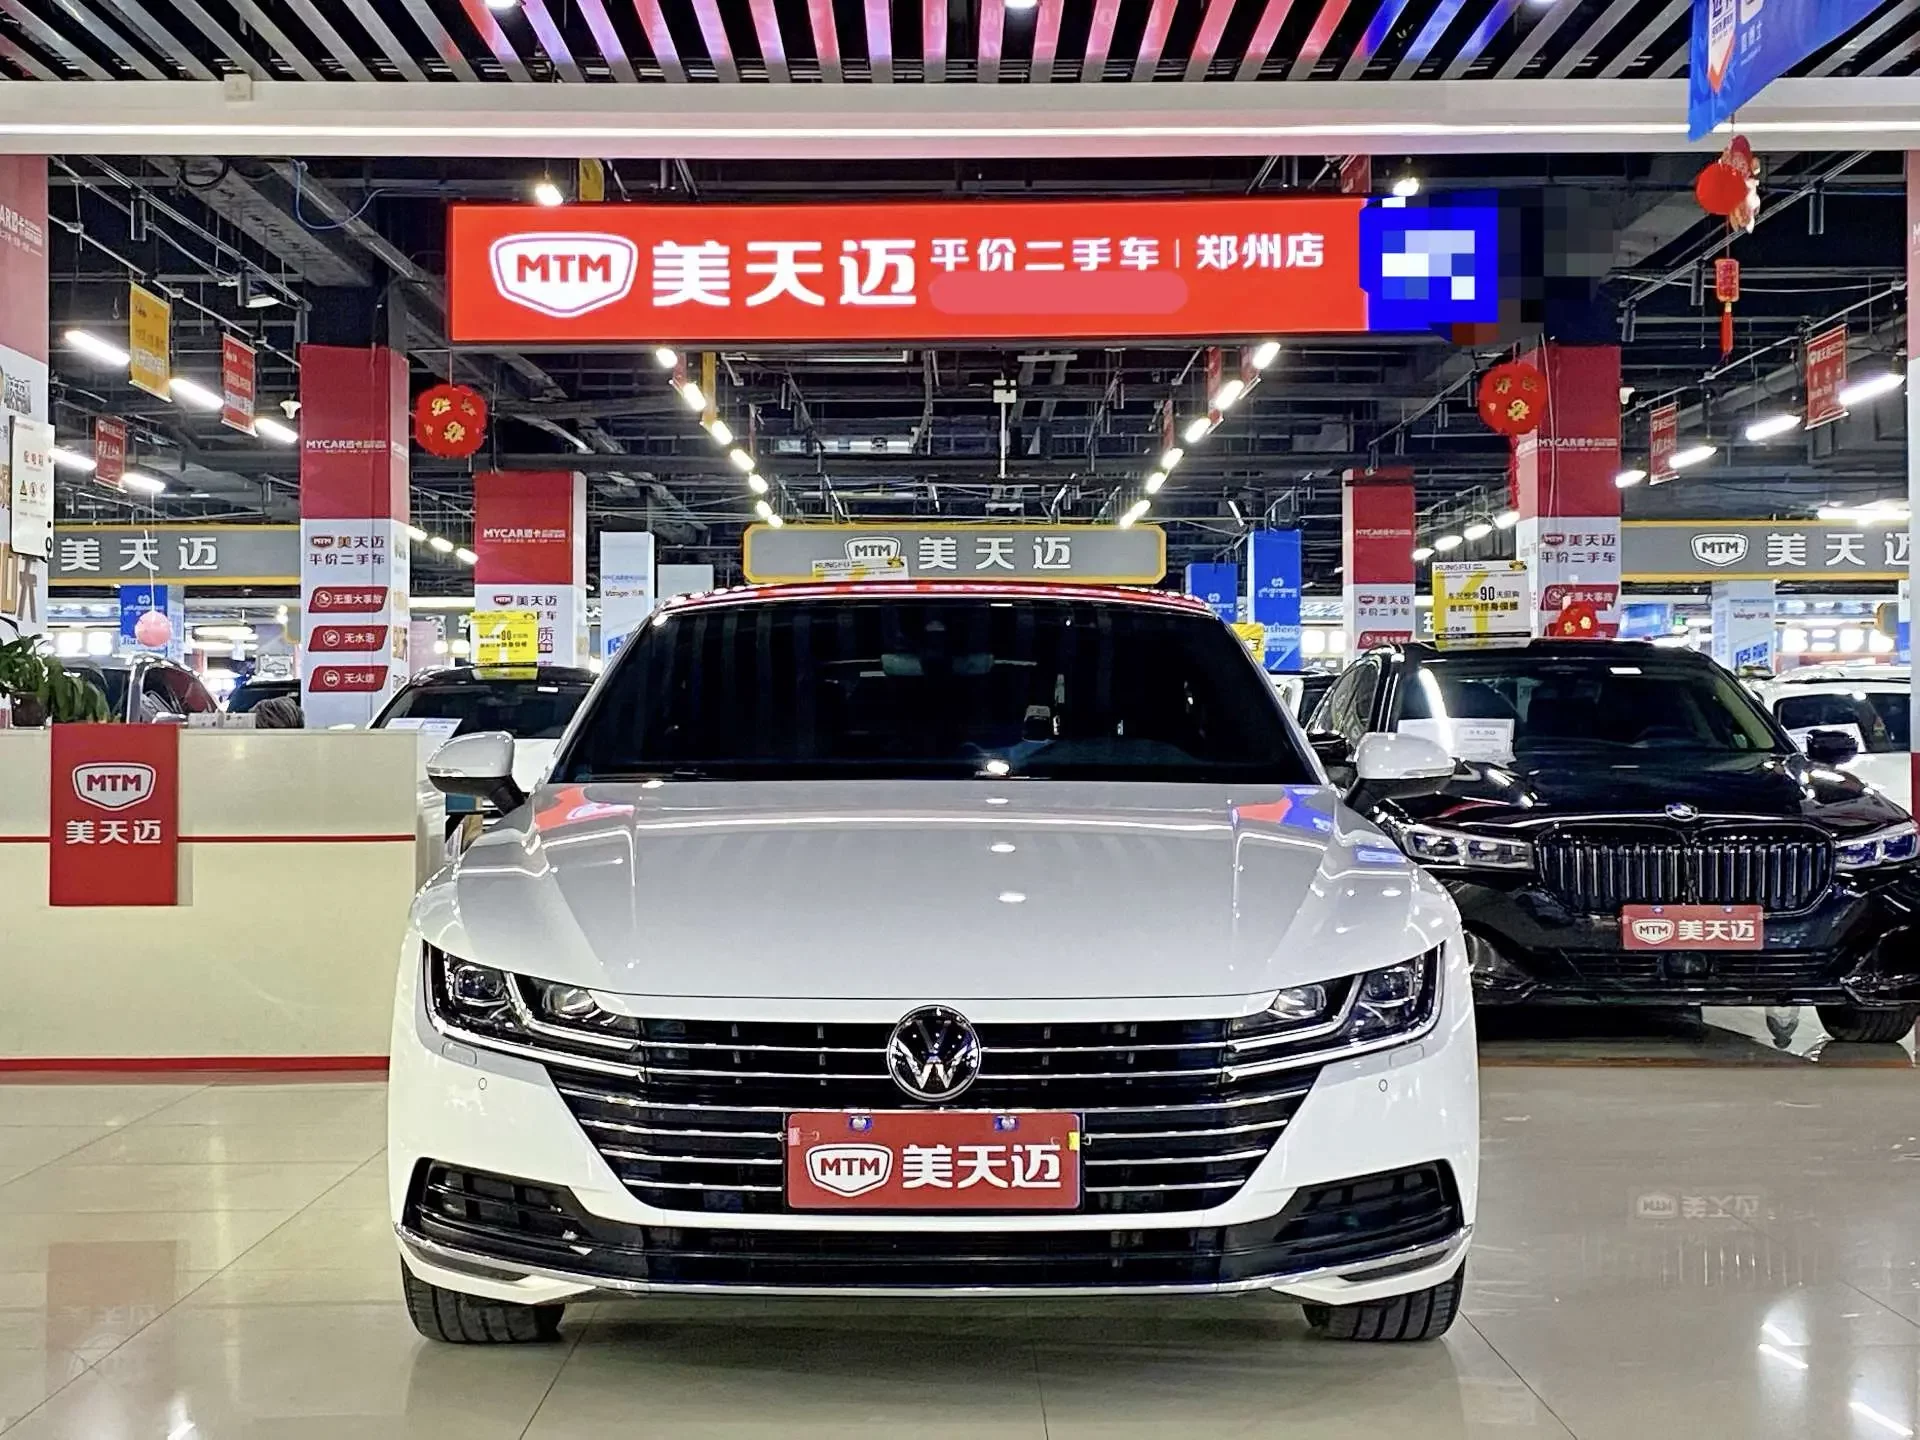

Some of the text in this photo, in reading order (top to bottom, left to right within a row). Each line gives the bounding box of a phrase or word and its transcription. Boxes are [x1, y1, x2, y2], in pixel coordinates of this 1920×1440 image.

[930, 233, 1325, 272] 平价二手车 郑州店
[517, 239, 917, 308] MTM 美天迈
[337, 535, 384, 549] 美天迈
[1568, 533, 1615, 547] 美天迈
[1701, 533, 1910, 567] MTM 美天迈
[60, 536, 218, 572] 美天迈
[309, 553, 385, 566] 平价二手车
[854, 536, 1072, 569] MTM 美天迈
[1541, 552, 1616, 564] 平价二手车
[333, 594, 383, 605] 无重大事故
[516, 595, 558, 606] 美天迈
[1377, 595, 1410, 605] 美天迈
[86, 773, 142, 792] MTM
[65, 819, 162, 845] 美天迈
[1638, 919, 1756, 941] MTM 美天迈
[820, 1143, 1061, 1189] MTM 美天迈
